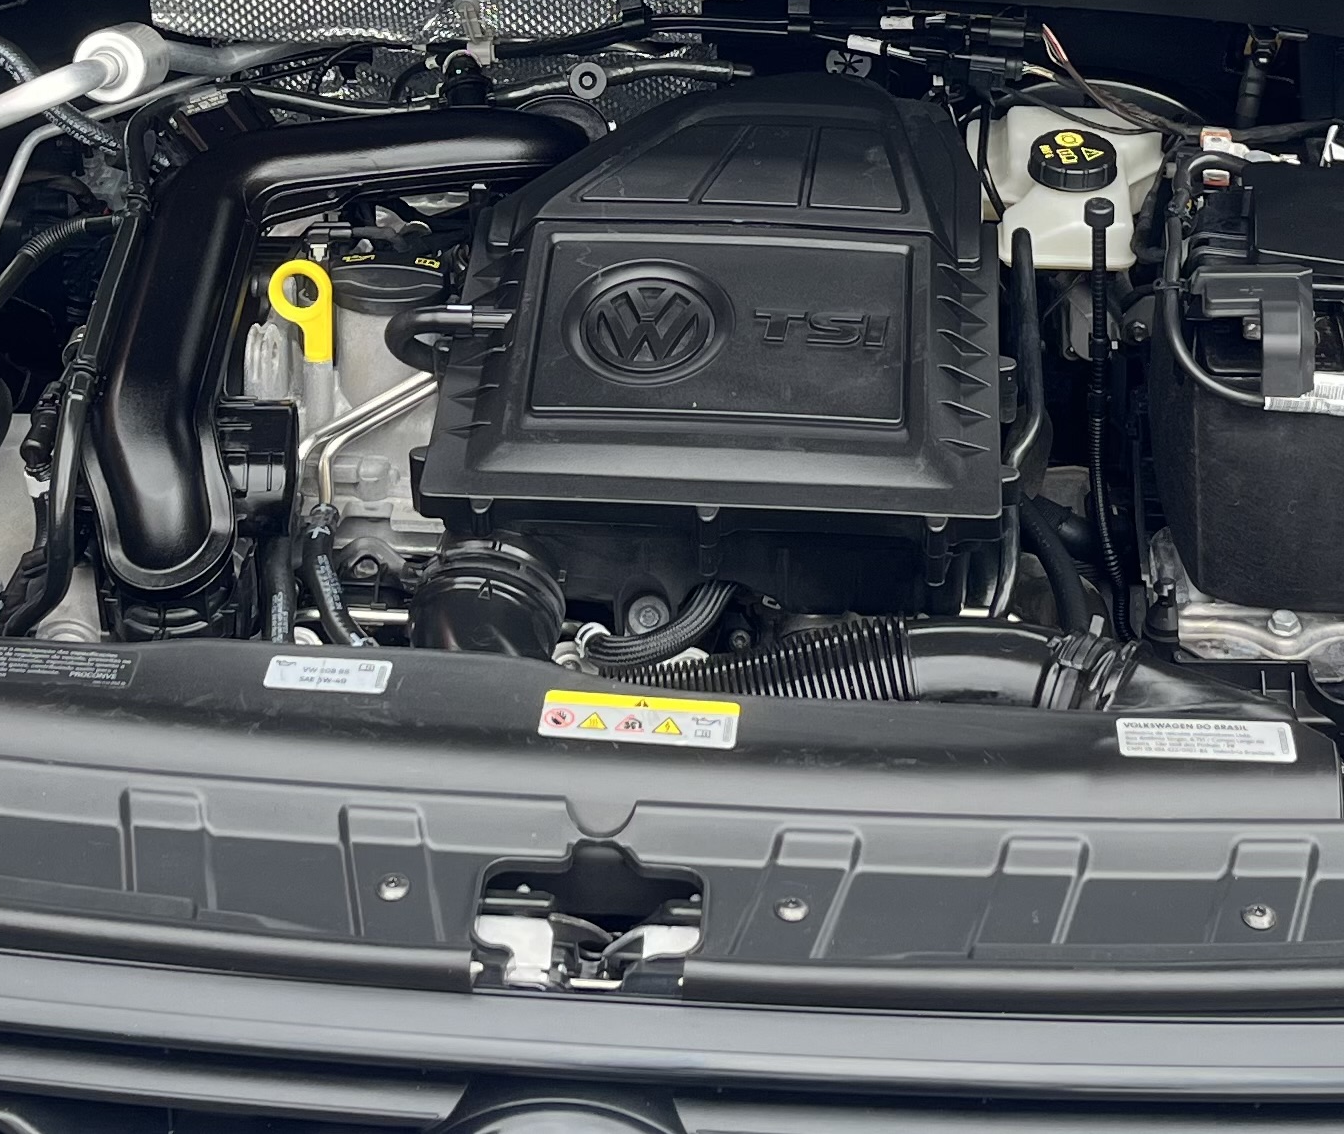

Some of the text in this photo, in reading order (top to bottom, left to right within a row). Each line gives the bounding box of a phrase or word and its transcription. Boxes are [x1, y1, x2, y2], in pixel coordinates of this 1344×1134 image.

[581, 278, 715, 371] VW
[755, 308, 890, 350] TSI
[1123, 722, 1193, 730] VOLKSWAGEN
[1214, 723, 1248, 731] BRASIL
